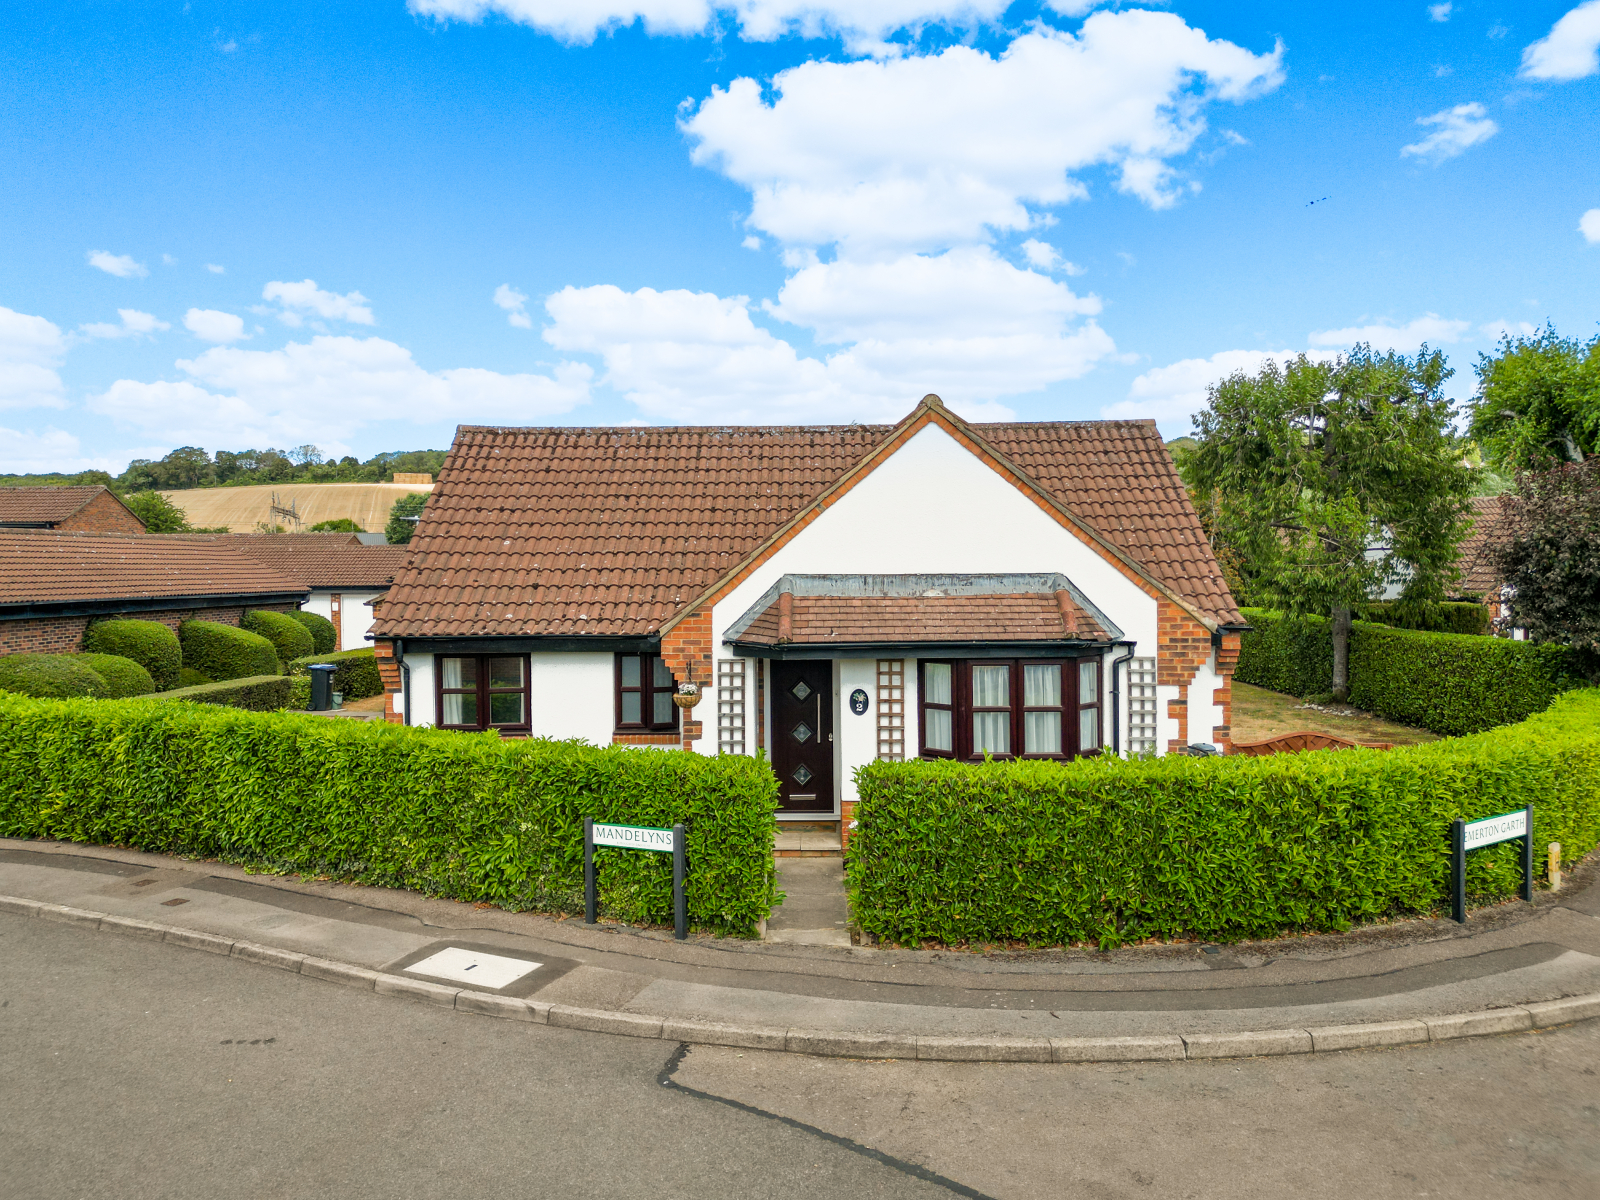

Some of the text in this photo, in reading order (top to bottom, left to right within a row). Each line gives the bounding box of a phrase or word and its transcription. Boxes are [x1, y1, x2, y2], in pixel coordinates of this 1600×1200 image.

[855, 703, 863, 712] 2
[595, 826, 672, 845] MANDELYNS
[1464, 824, 1499, 843] EMERTON
[1501, 817, 1525, 833] GARTH
